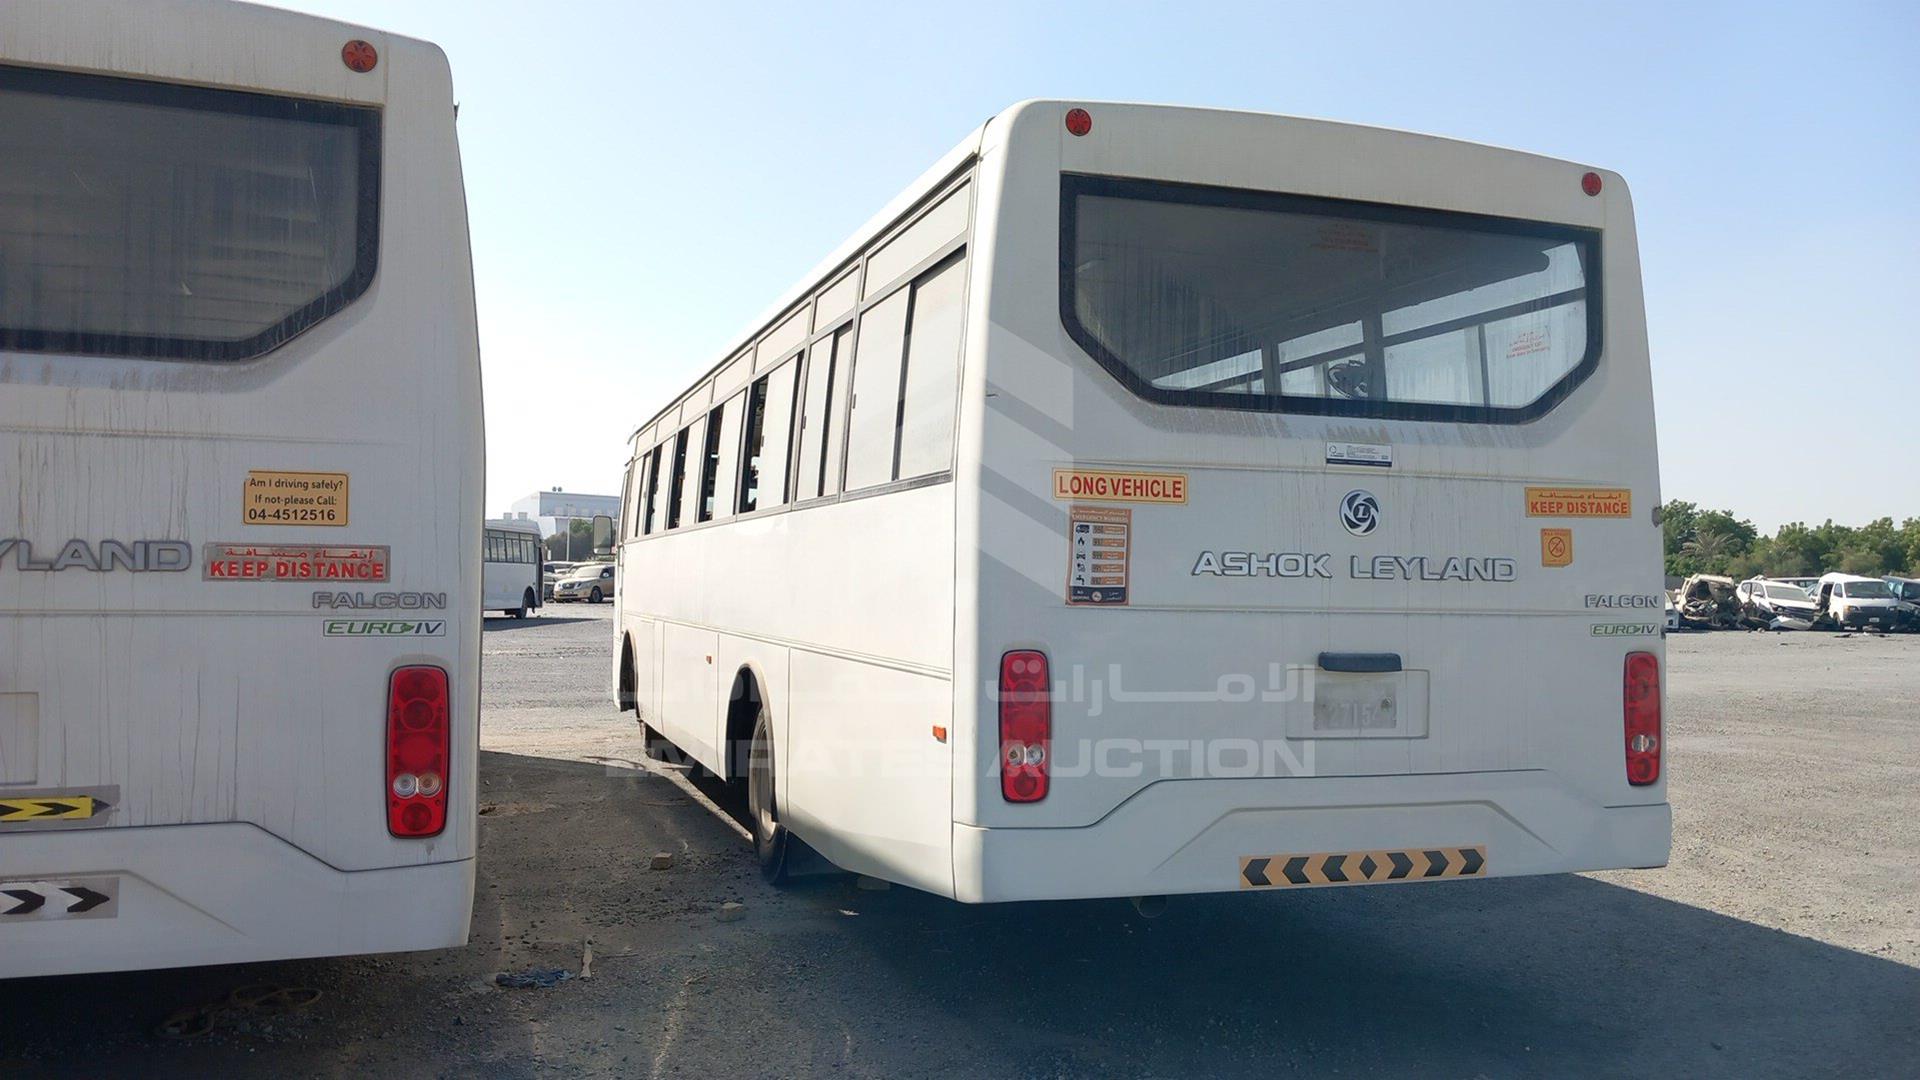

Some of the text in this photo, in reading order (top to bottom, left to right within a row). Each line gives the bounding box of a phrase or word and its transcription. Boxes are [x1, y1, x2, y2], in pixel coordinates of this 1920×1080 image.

[249, 478, 344, 491] Am I driving safely?
[1059, 475, 1182, 498] LONG VEHICLE
[254, 494, 263, 503] If
[316, 495, 337, 506] Call:
[248, 508, 336, 521] 04-4512516
[1530, 501, 1628, 514] KEEP DISTANCE
[210, 560, 384, 578] KEEP DISTANCE
[1191, 550, 1520, 582] ASHOK LEYLAND
[311, 592, 447, 609] FALCON
[1584, 594, 1659, 608] FALCON
